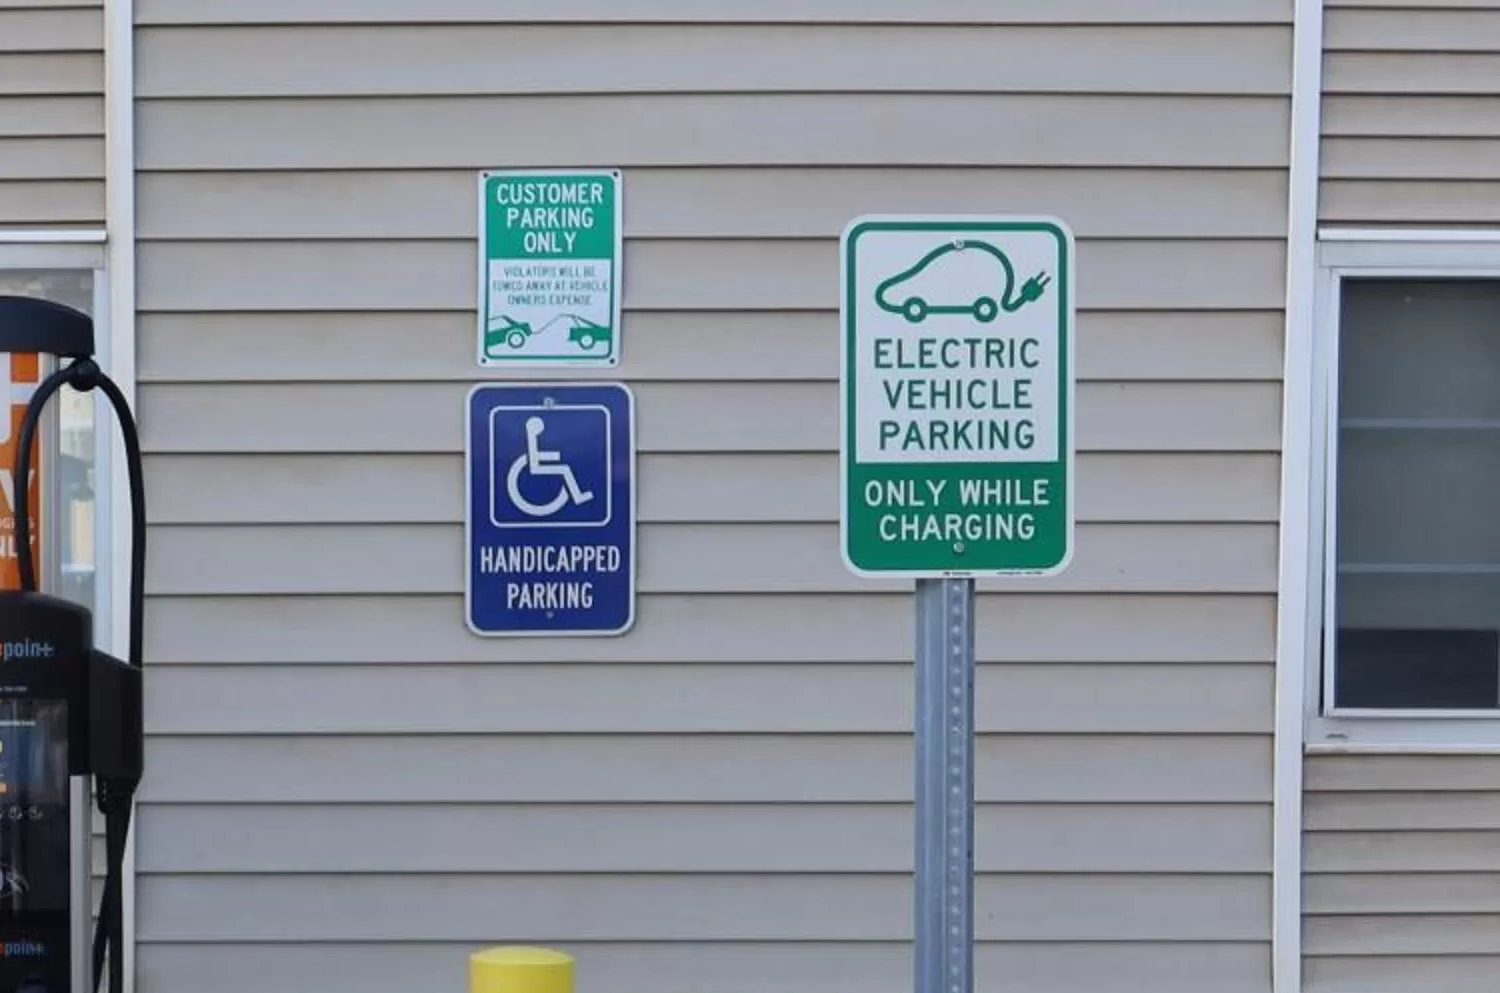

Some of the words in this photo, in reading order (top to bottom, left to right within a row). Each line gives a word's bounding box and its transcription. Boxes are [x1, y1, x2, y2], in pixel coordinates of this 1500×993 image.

[496, 183, 603, 205] CUSTOMER
[507, 207, 594, 229] PARKING
[524, 232, 577, 253] ONLY
[560, 266, 580, 277] WILL
[526, 280, 551, 291] AWAY
[554, 279, 565, 290] AT
[874, 338, 1040, 369] ELECTRIC
[883, 379, 1033, 409] VEHICLE
[879, 420, 1035, 450] PARKING
[864, 480, 947, 507] ONLY
[959, 480, 1050, 506] WHILE
[879, 514, 1036, 541] CHARGING
[480, 545, 620, 573] HANDICAPPED
[507, 583, 593, 609] PARKING
